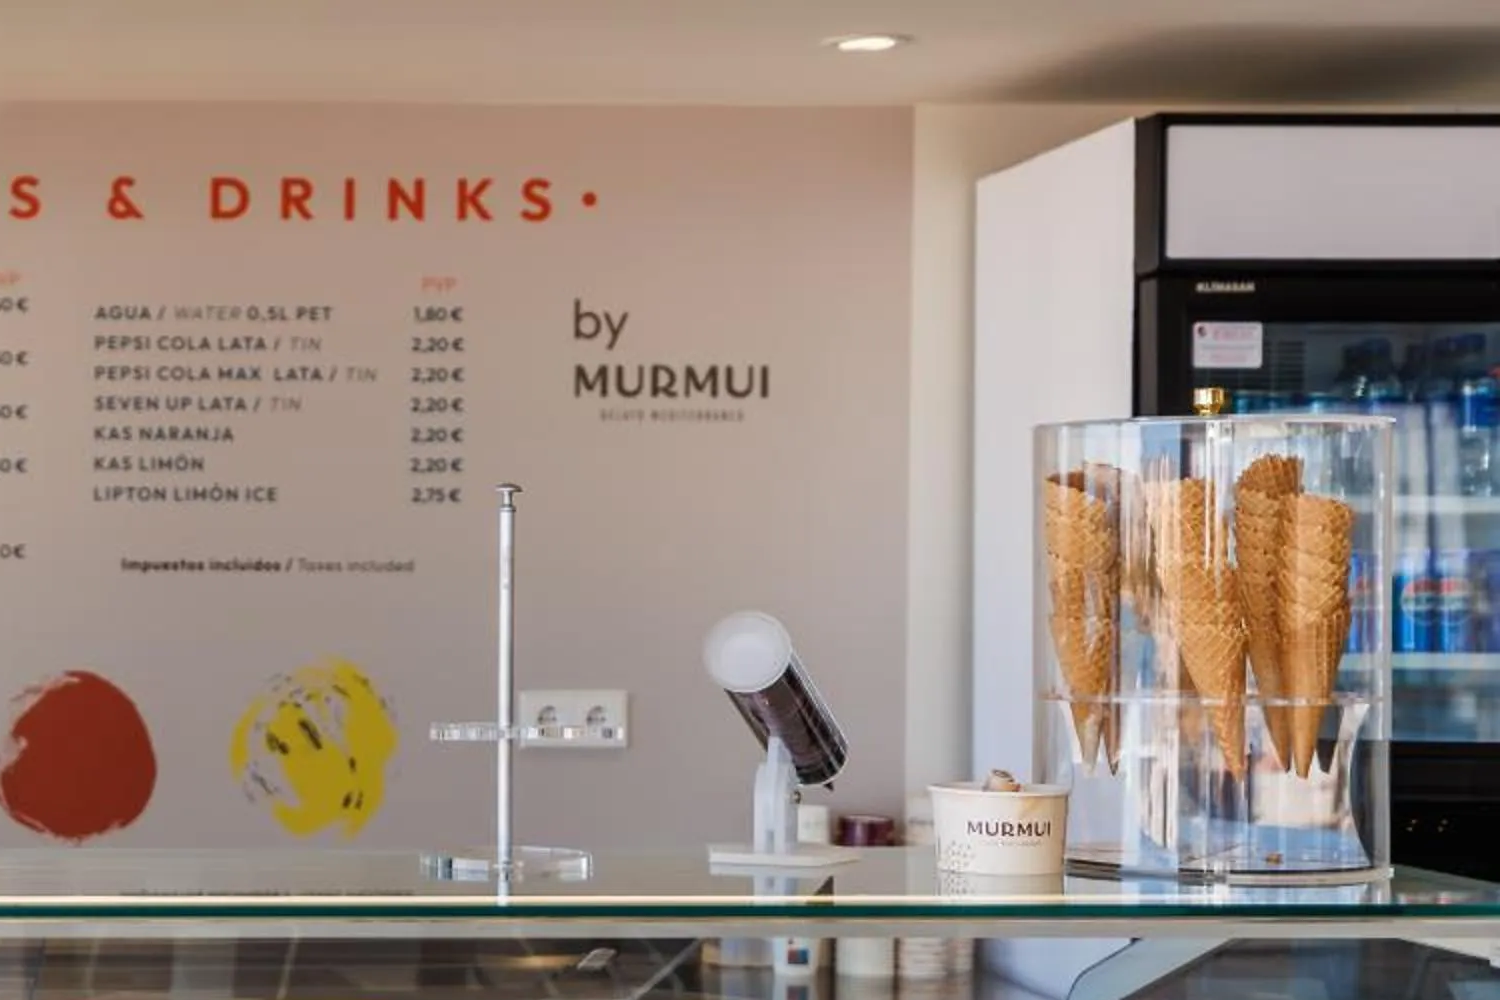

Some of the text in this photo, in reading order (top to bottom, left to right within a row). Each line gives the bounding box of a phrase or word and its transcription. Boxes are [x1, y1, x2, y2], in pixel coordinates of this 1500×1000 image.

[106, 176, 144, 221] &
[210, 177, 554, 222] DRINKS
[93, 305, 152, 320] AGUA
[174, 305, 242, 321] WATER
[295, 306, 334, 322] PET
[573, 298, 630, 350] by
[93, 335, 322, 351] PEPSI COLA LATA TIN
[93, 365, 377, 382] PEPSI COLA MAX LATA TIN
[573, 364, 770, 399] MURMUI
[93, 395, 302, 412] SEVEN UP LATA TIN
[93, 427, 235, 441] KAS NARANJA
[92, 457, 133, 471] KAS
[92, 486, 168, 502] LIPTON
[244, 486, 278, 503] ICE
[966, 820, 1052, 838] MURMUI
